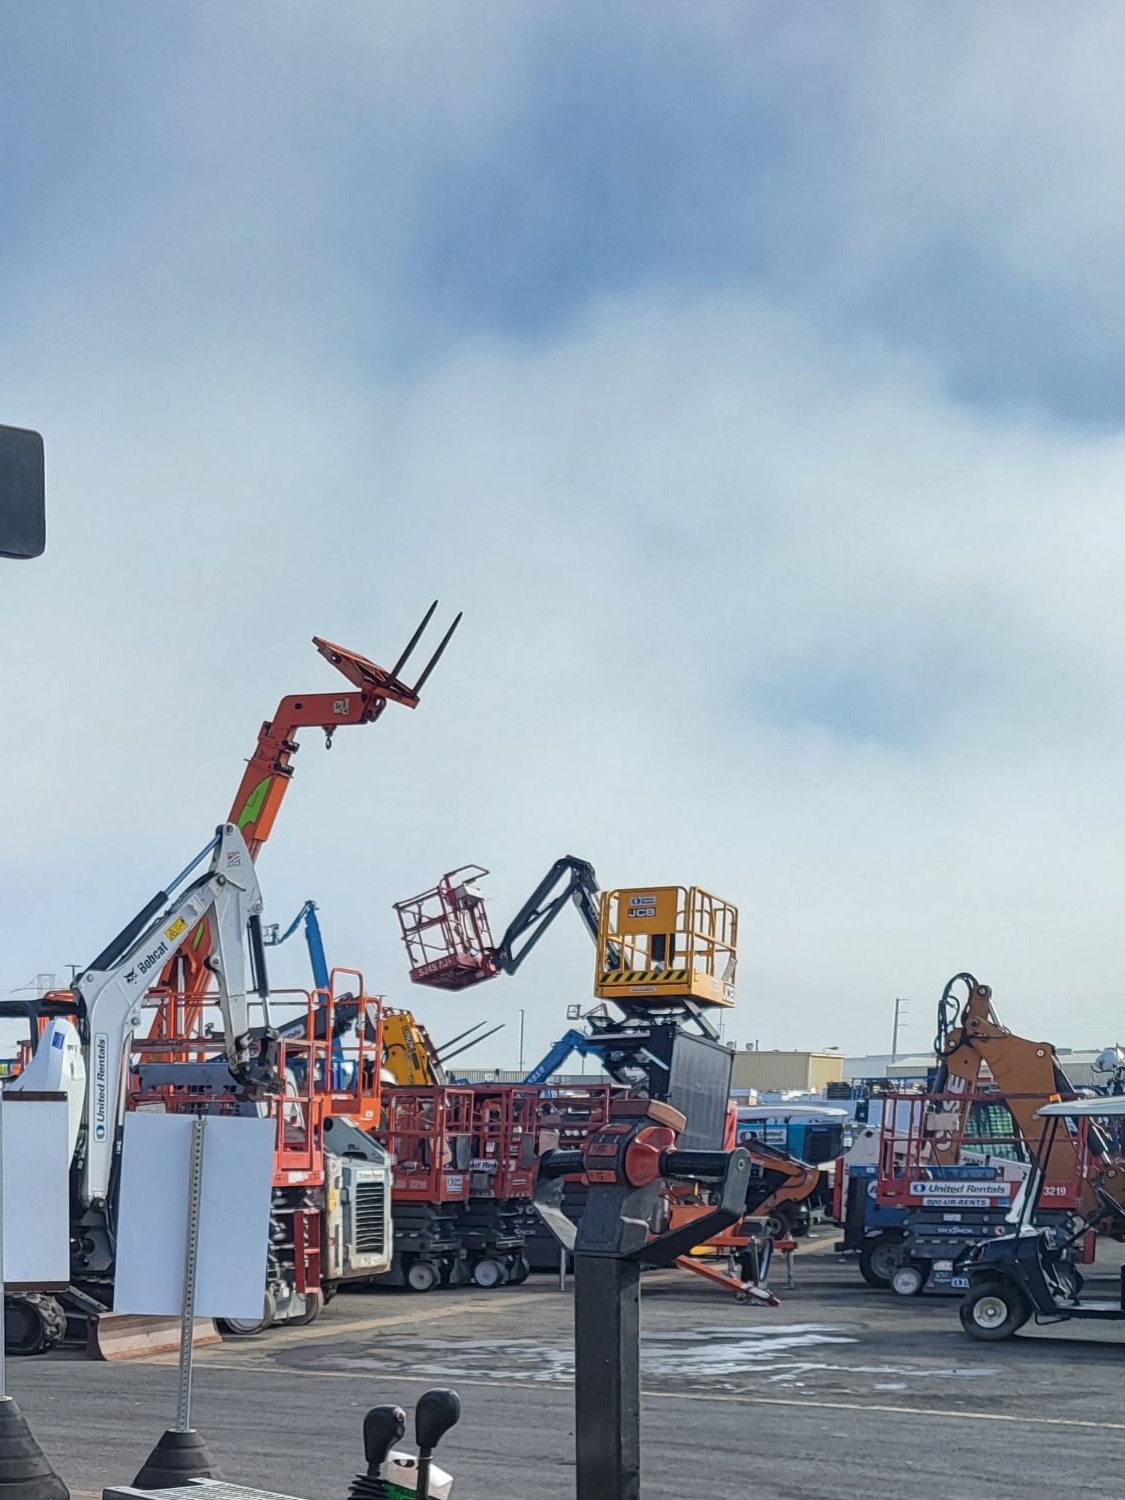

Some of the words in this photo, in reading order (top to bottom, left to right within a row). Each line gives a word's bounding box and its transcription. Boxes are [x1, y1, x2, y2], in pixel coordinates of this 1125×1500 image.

[629, 908, 655, 918] JCB
[138, 941, 169, 975] Bobcat
[96, 1038, 106, 1081] Rentals
[96, 1085, 106, 1122] United
[935, 1074, 966, 1151] CSE
[929, 1184, 964, 1194] United
[966, 1185, 1006, 1194] Rentals
[1043, 1186, 1066, 1196] 3219
